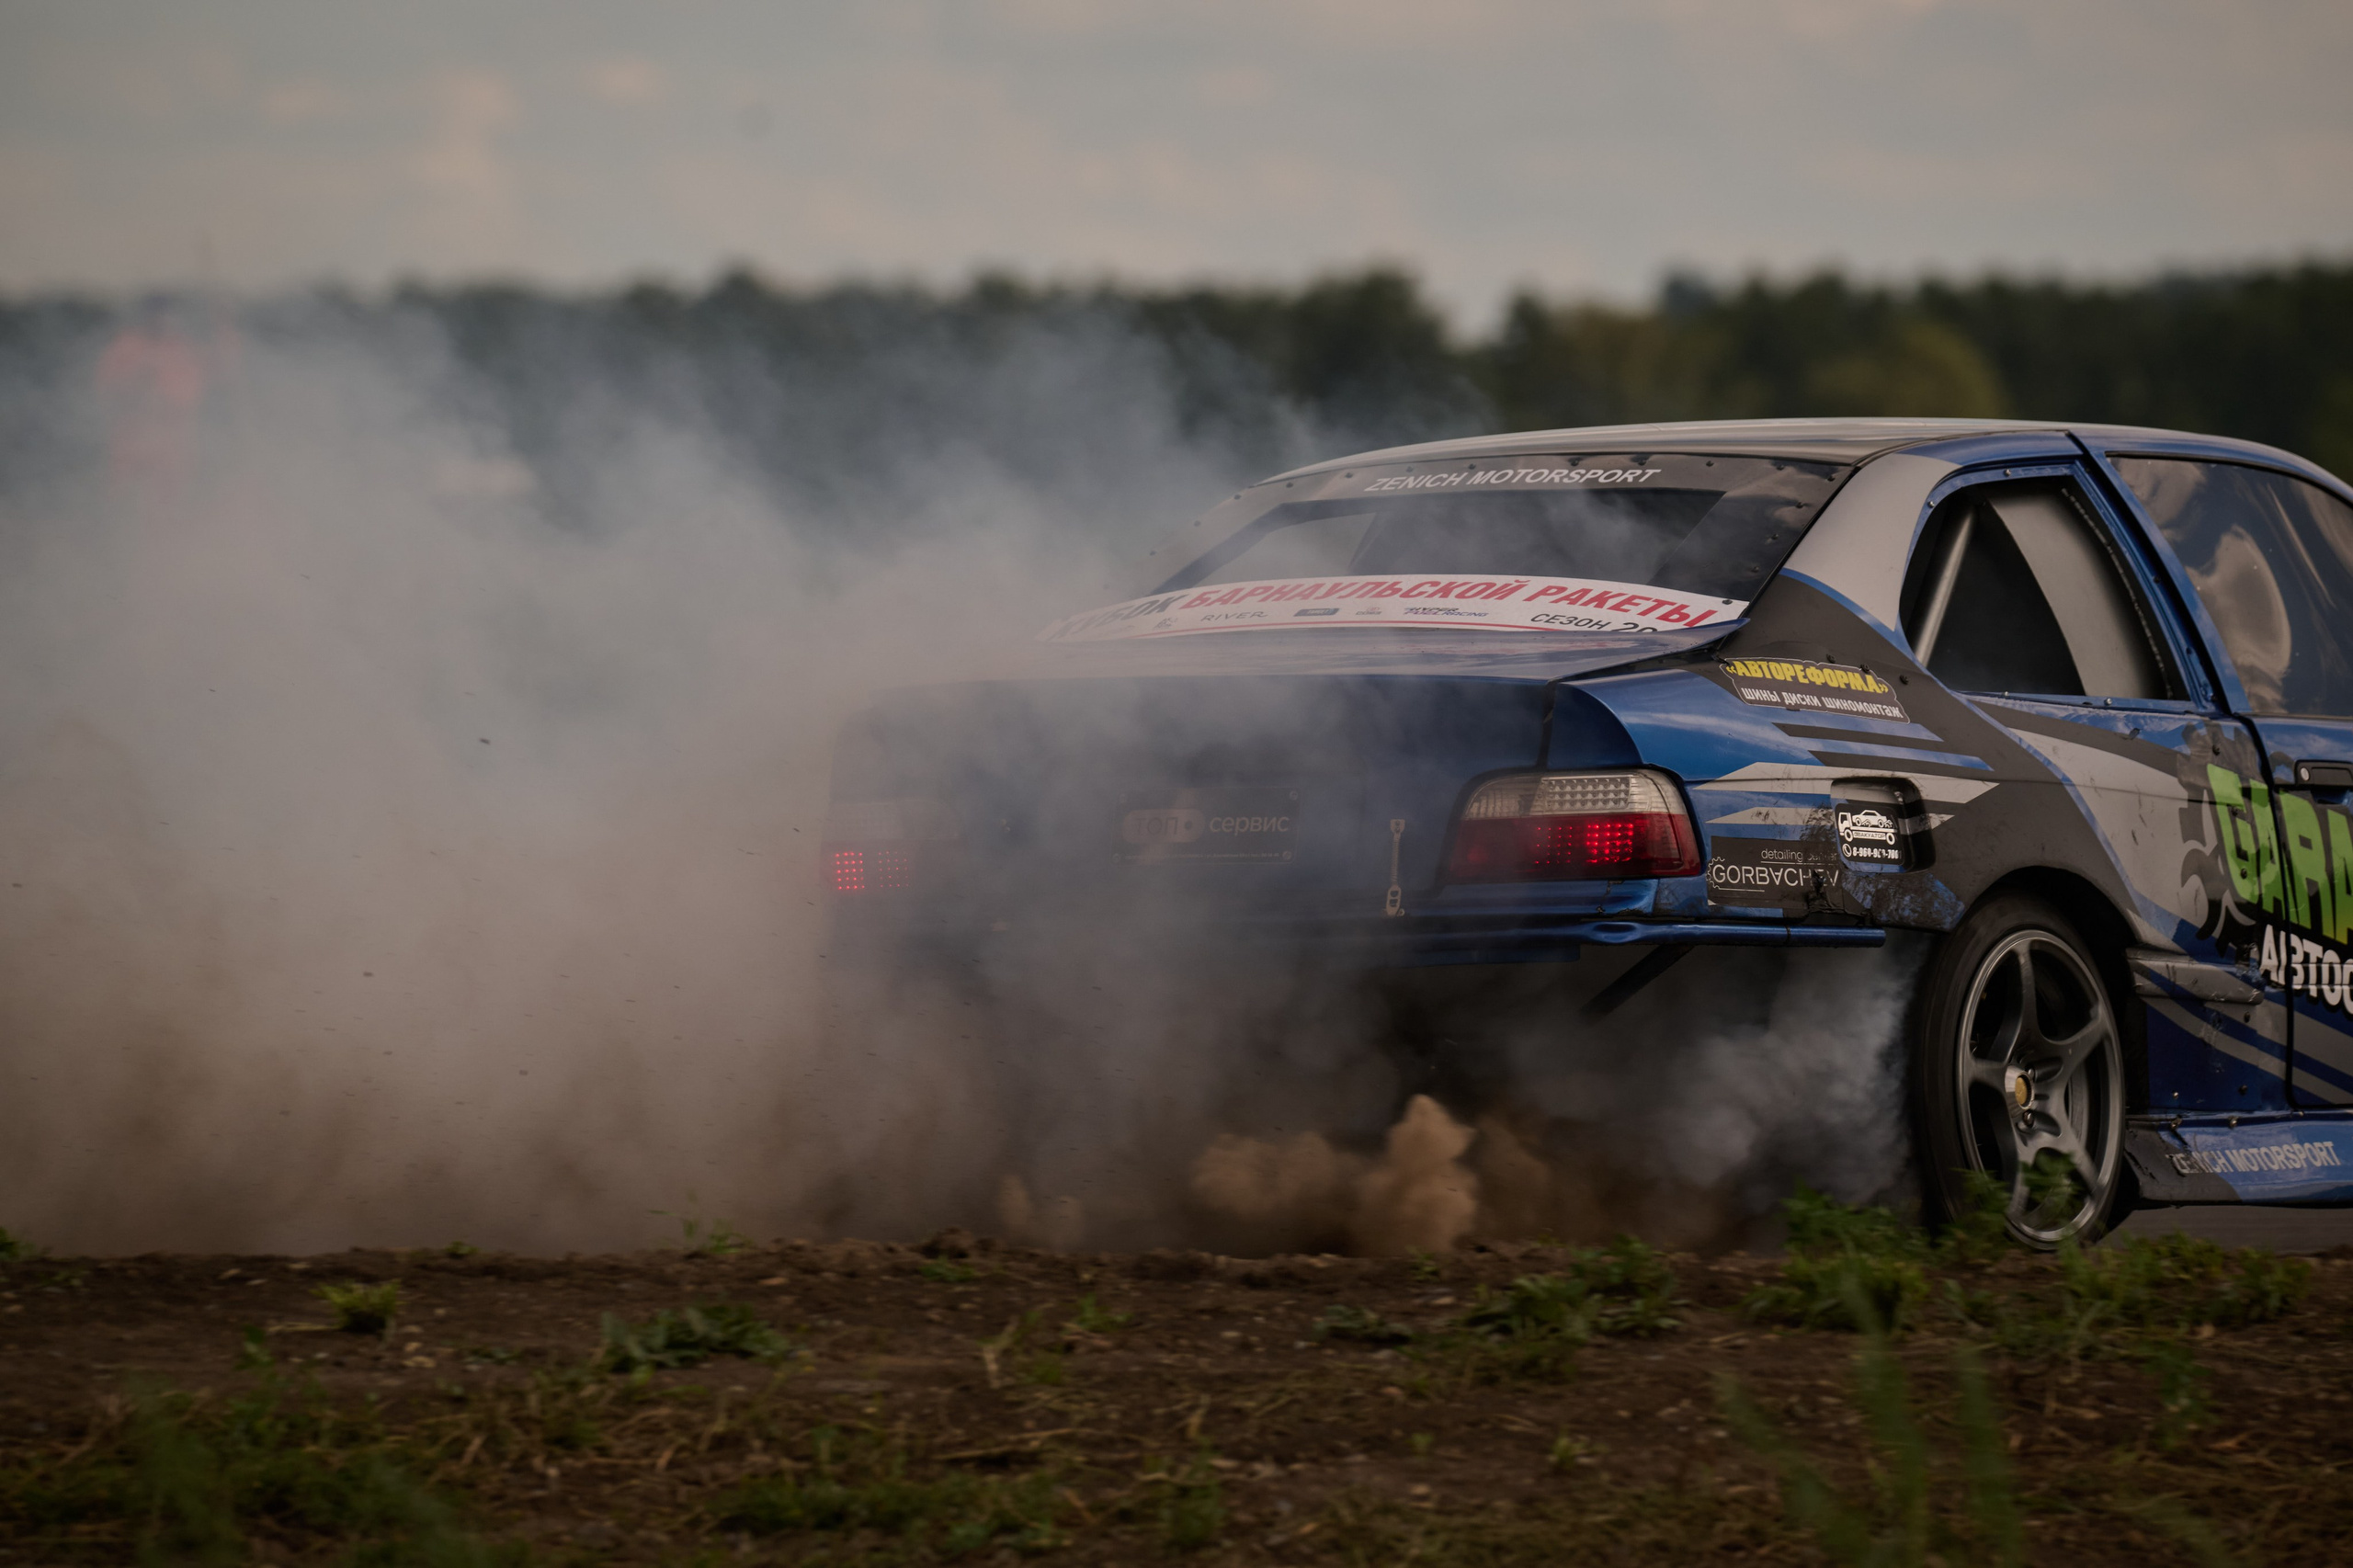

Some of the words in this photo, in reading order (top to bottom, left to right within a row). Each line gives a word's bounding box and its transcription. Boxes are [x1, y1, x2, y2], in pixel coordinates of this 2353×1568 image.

[1364, 472, 1468, 492] ZENICH
[1466, 469, 1662, 485] MOTORSPORT
[1178, 579, 1530, 609] БАРНАУЛЬСКОЙ
[1522, 585, 1718, 627] РАКЕТЫ
[1199, 610, 1269, 622] RIVER
[1529, 613, 1611, 631] СЕЗОН
[1209, 815, 1290, 836] сервис
[1760, 848, 1803, 863] detailing
[2224, 1141, 2341, 1173] MOTORSPORT
